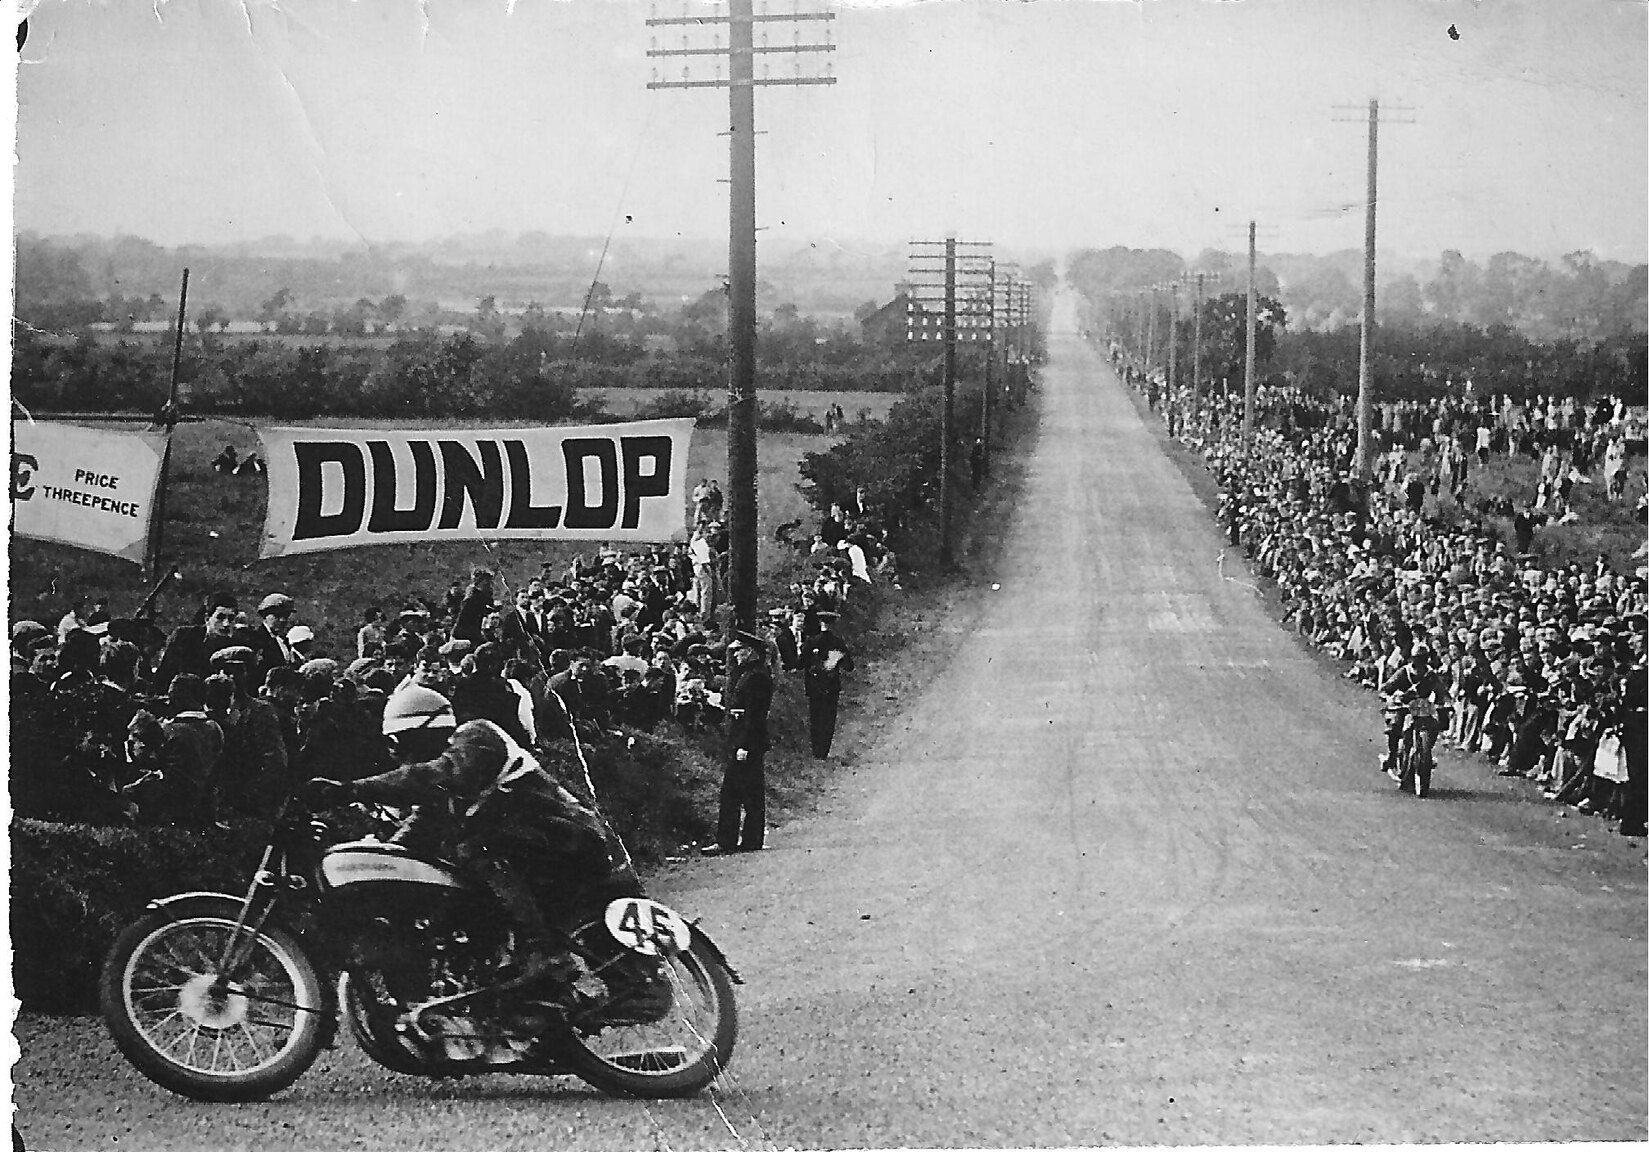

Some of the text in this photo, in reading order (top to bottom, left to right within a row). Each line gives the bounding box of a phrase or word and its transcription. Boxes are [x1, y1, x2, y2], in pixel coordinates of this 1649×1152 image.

[74, 468, 119, 490] PRICE
[292, 436, 672, 541] DUNLOP
[43, 485, 140, 518] THREEPENCE
